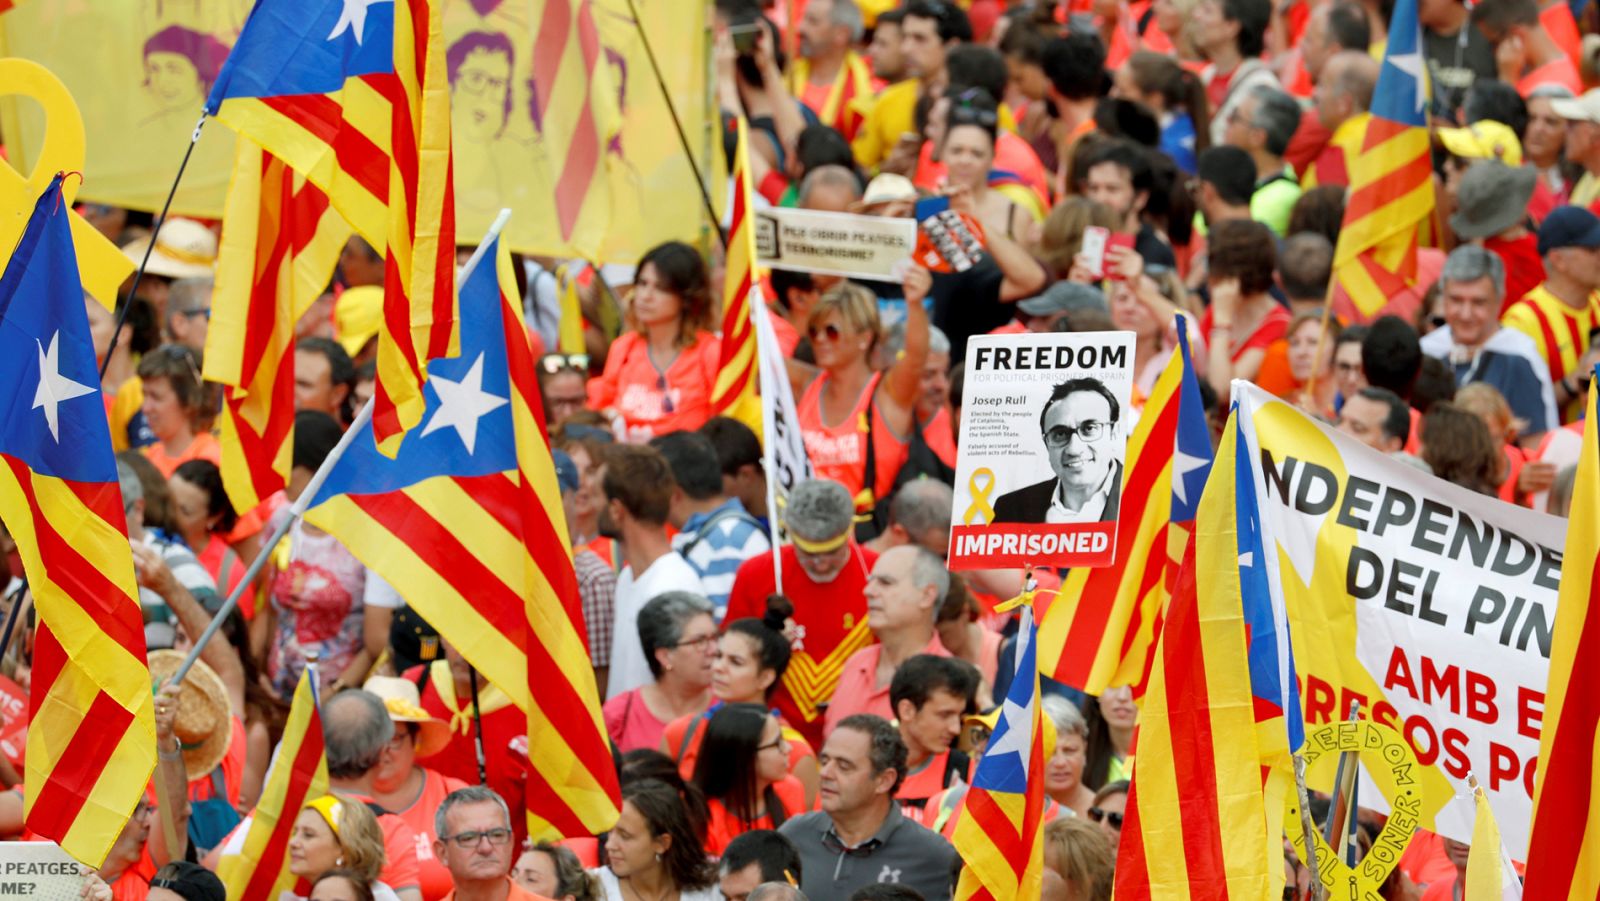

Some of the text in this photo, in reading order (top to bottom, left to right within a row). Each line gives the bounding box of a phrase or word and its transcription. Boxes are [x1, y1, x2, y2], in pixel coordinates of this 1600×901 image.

[974, 345, 1127, 371] FREEDOM
[973, 373, 991, 383] FOR
[993, 372, 1038, 383] POLITICAL
[1099, 371, 1126, 381] SPAIN
[972, 395, 1027, 408] Josep Rull
[1261, 447, 1562, 591] NDEPENDE
[955, 532, 1109, 557] IMPRISONED
[1346, 545, 1556, 660] DEL PIN
[1384, 645, 1546, 741] AMB E
[1304, 723, 1415, 786] REEDOM
[1, 882, 37, 896] ME?
